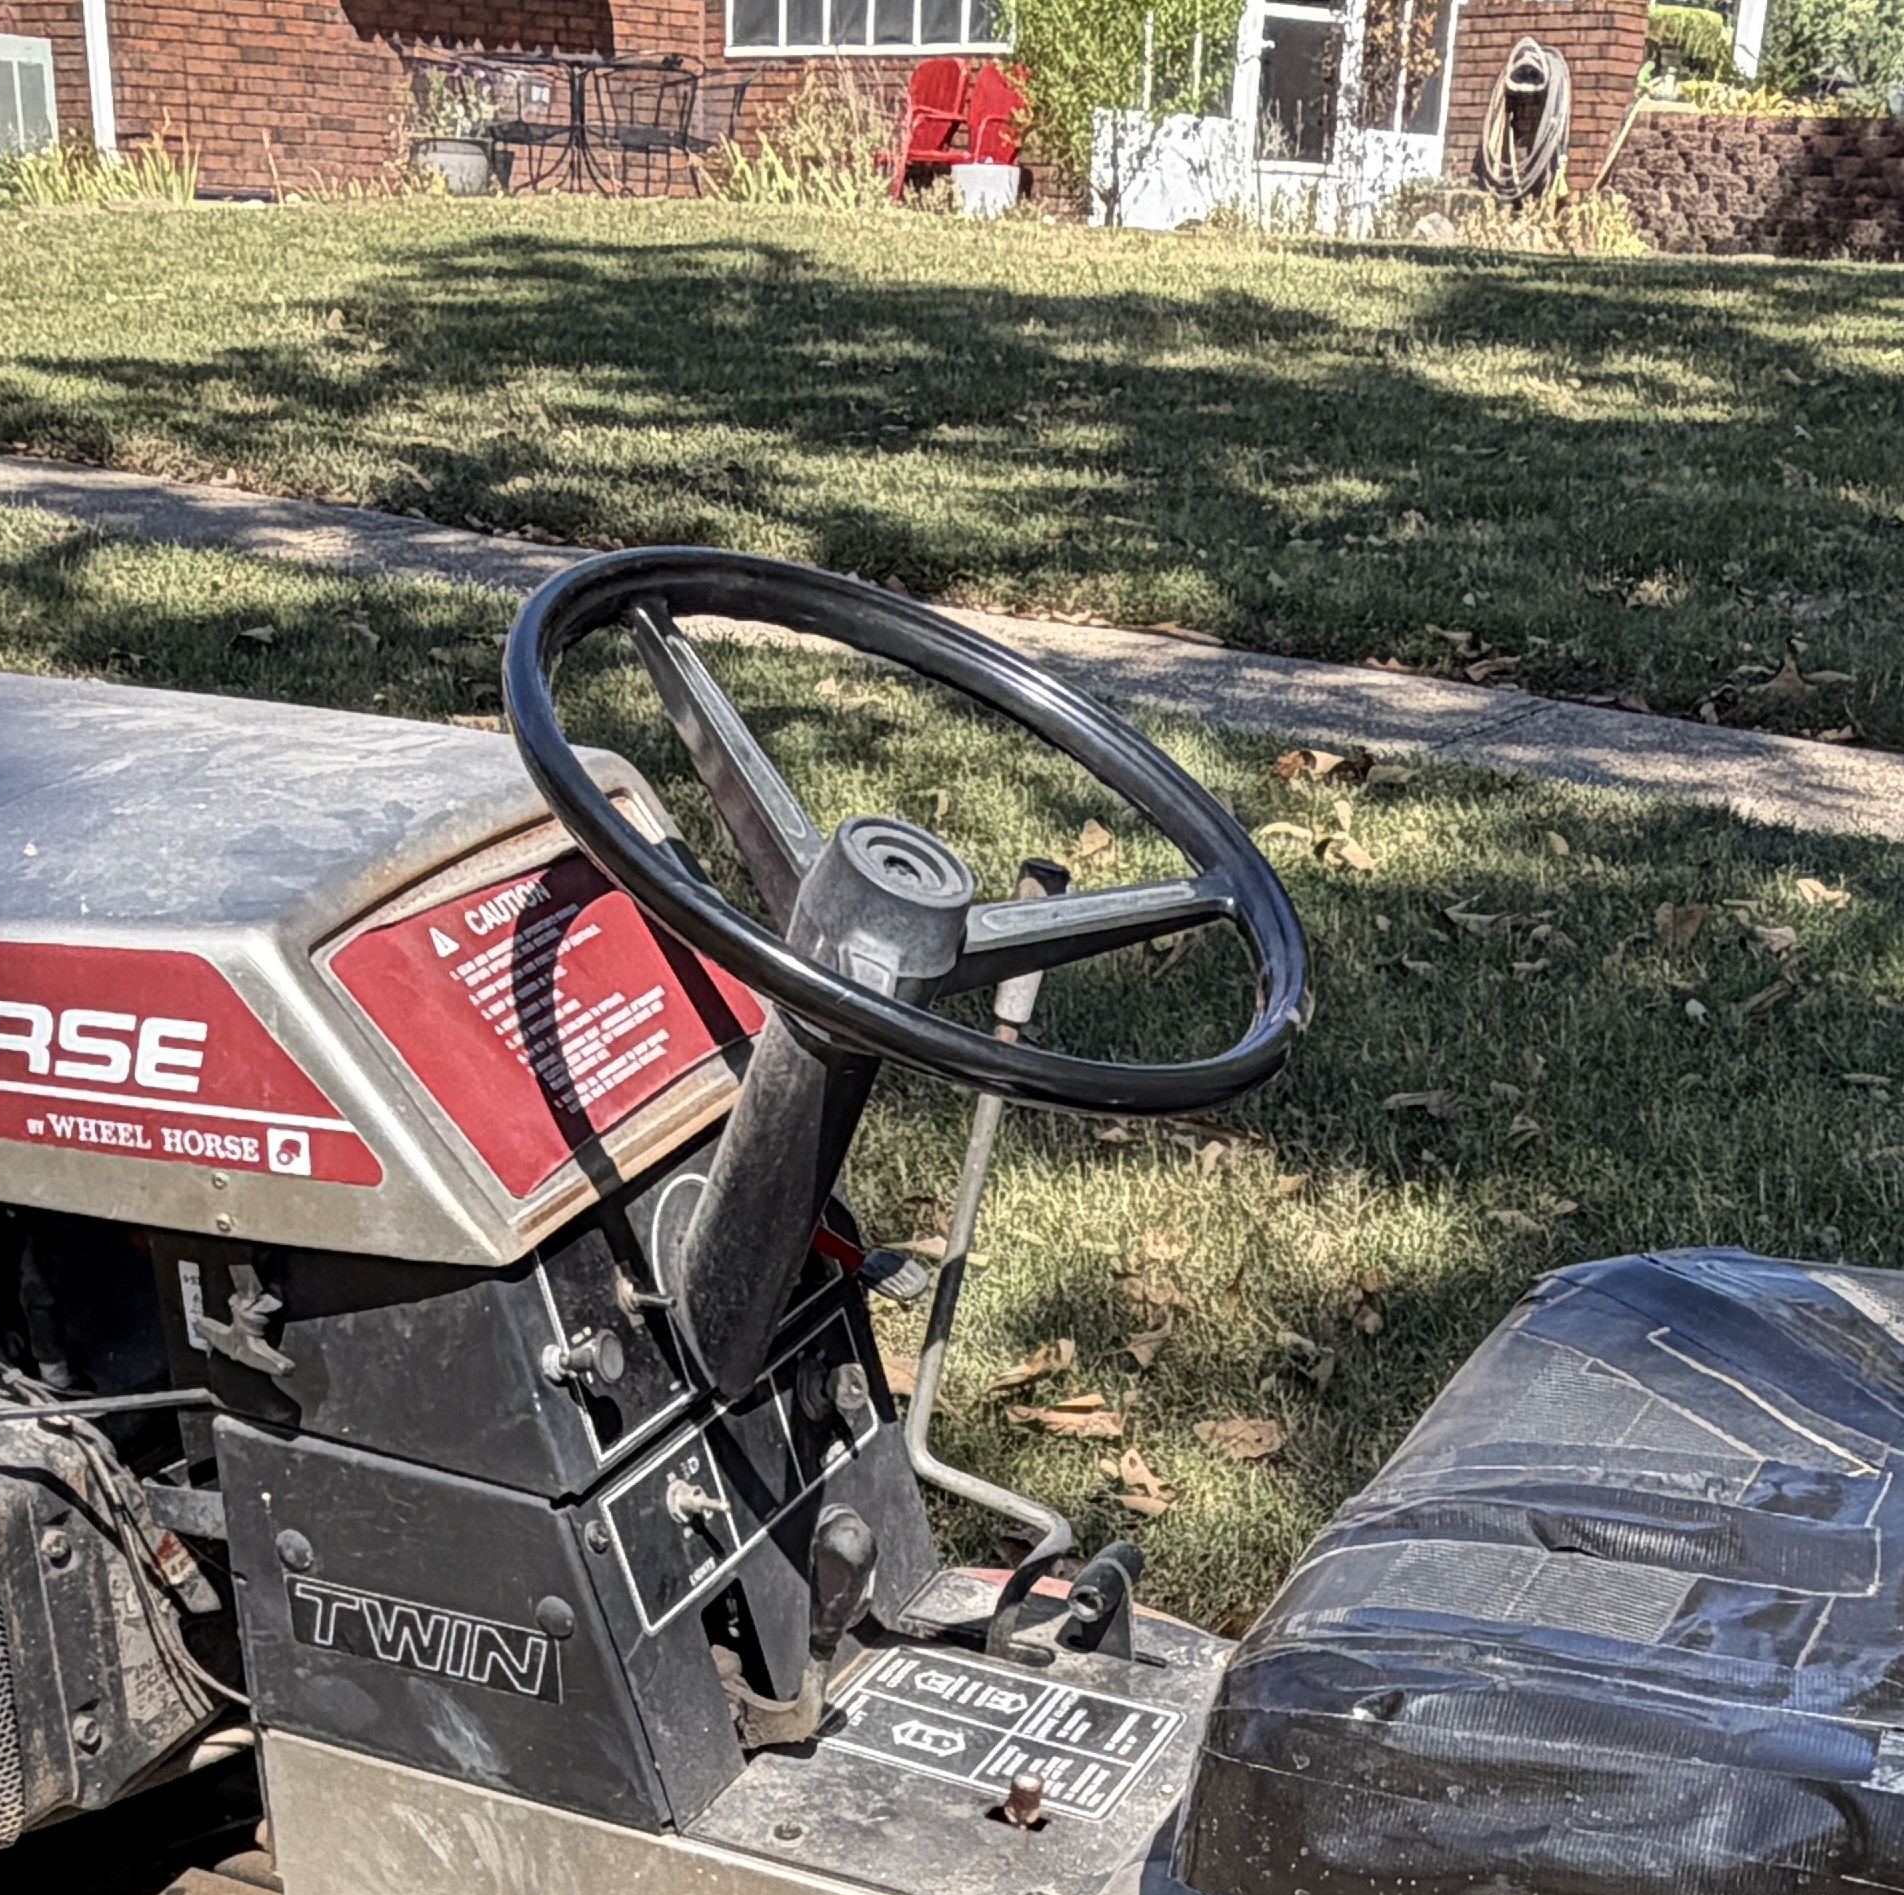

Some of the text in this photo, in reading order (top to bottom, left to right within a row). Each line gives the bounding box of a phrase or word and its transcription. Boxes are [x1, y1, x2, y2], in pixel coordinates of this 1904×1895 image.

[464, 880, 552, 935] CAUTION
[46, 1112, 152, 1150] WHEEL
[160, 1126, 260, 1162] HORSE
[295, 1582, 548, 1696] TWIN
